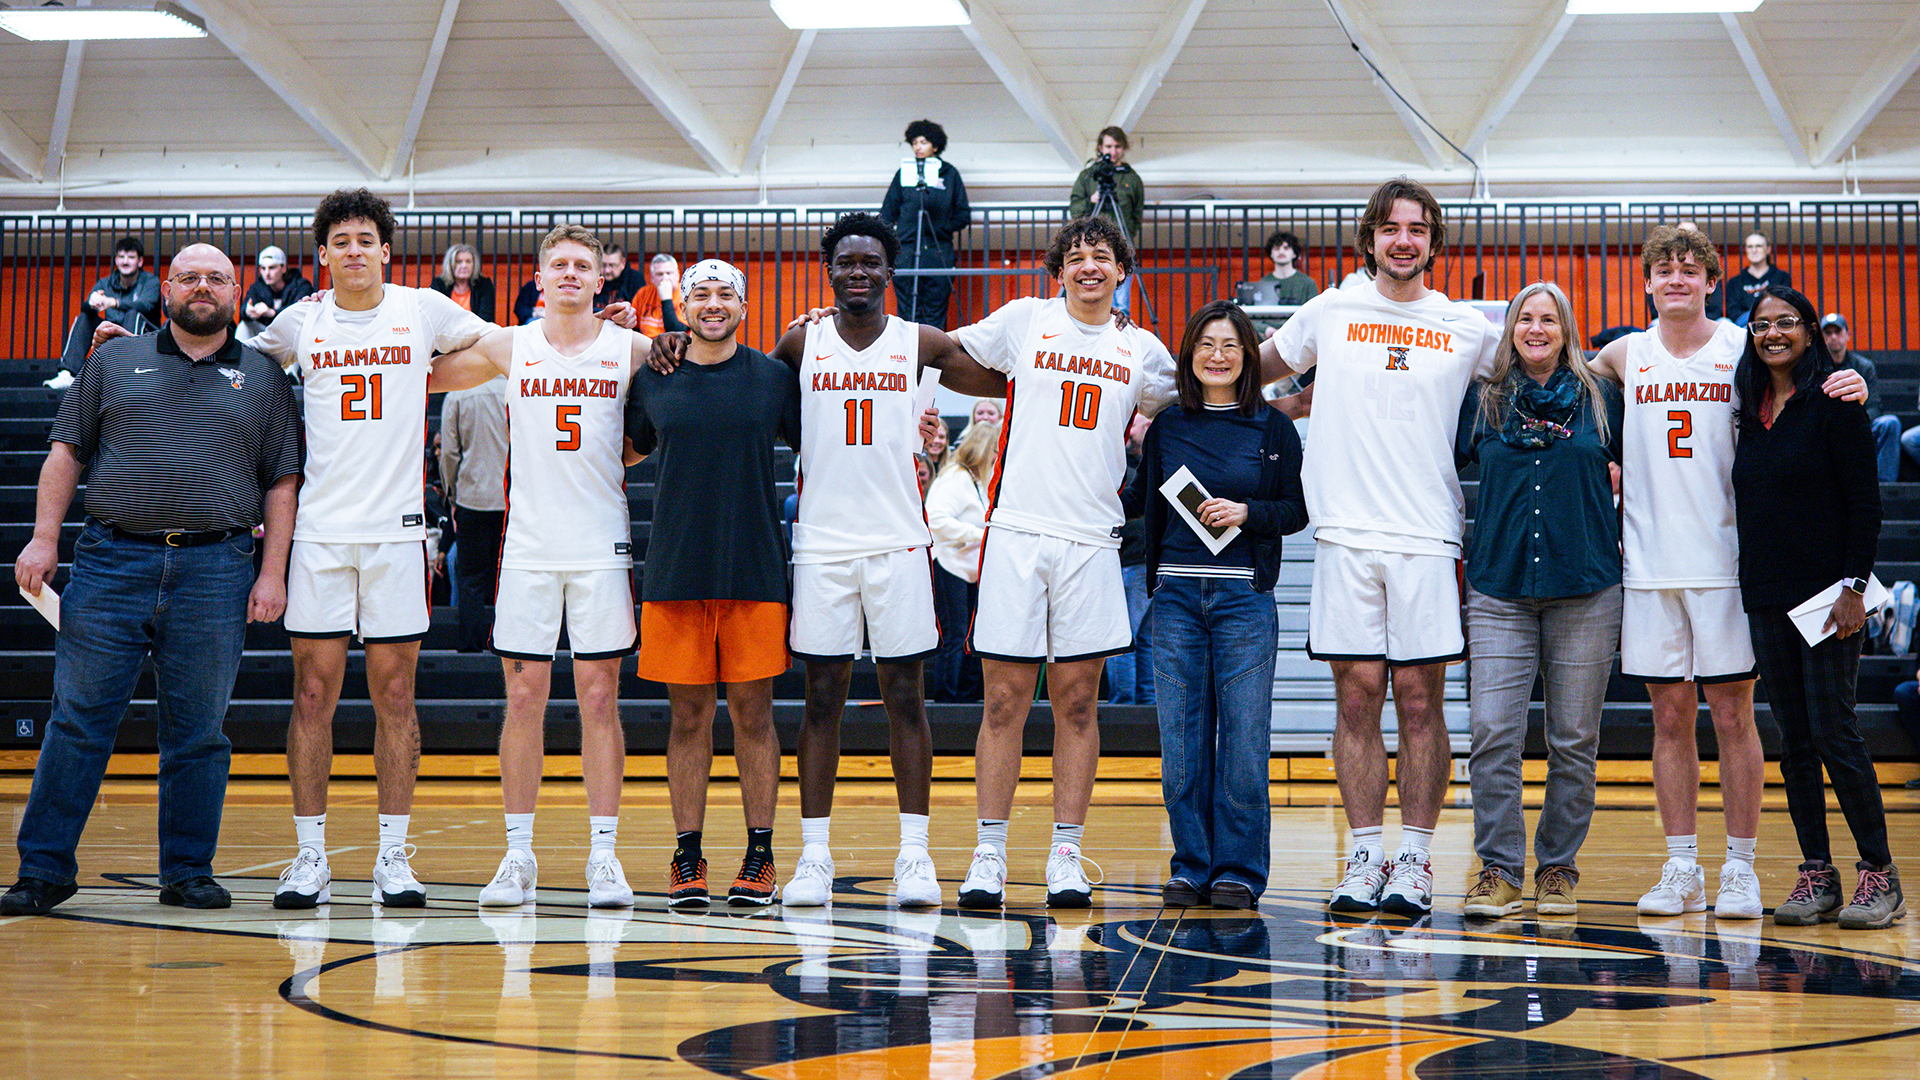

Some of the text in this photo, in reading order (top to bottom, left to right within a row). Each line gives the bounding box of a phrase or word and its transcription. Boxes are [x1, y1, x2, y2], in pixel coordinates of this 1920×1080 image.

[1347, 323, 1453, 353] NOTHING EASY.
[812, 372, 907, 392] KALAMAZOO
[1034, 350, 1130, 385] KALAMAZOO
[341, 373, 382, 421] 21
[520, 378, 618, 399] KALAMAZOO
[1059, 380, 1102, 431] 10
[1635, 382, 1731, 405] KALAMAZOO
[556, 405, 581, 451] 5
[844, 398, 873, 446] 11
[1667, 410, 1693, 459] 2
